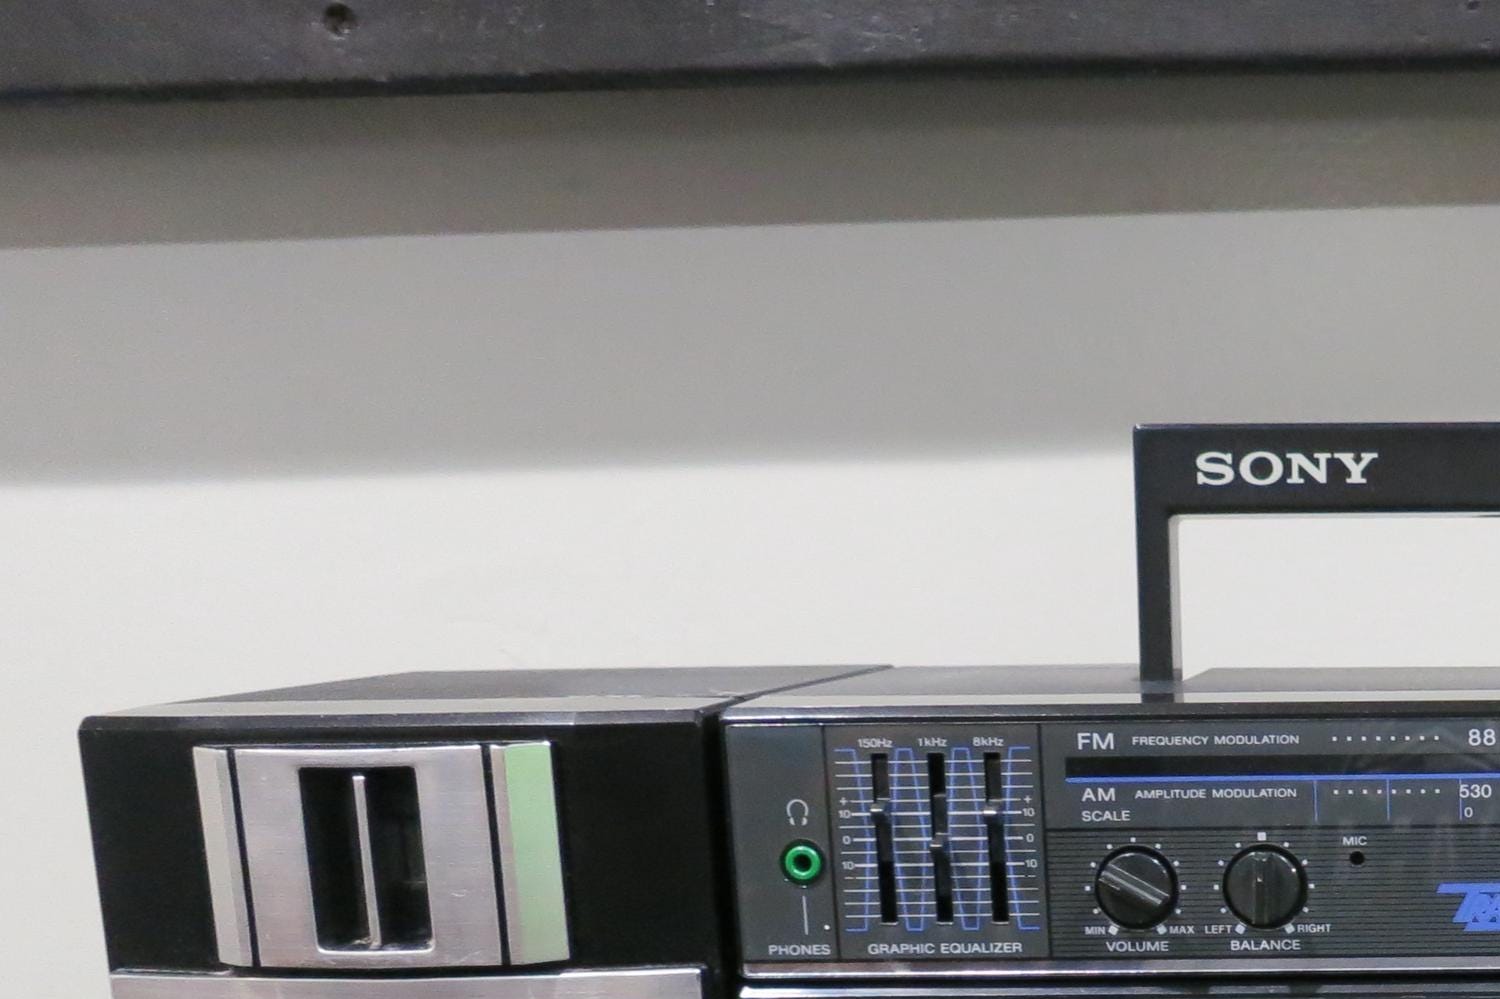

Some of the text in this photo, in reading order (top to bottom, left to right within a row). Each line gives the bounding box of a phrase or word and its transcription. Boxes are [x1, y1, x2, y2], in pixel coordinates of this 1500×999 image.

[1195, 451, 1379, 486] SONY
[918, 737, 947, 747] 1kHz
[972, 737, 1004, 747] 8kHz
[1077, 732, 1299, 750] FM FREQUENCY MODULATION
[1468, 729, 1496, 746] 88
[857, 738, 893, 748] 150Hz
[1081, 788, 1297, 801] AM AMPLITUDE MODULATION
[1459, 785, 1492, 798] 530
[838, 810, 851, 819] 10
[1022, 807, 1035, 817] 10
[1082, 810, 1130, 822] SCALE
[1464, 807, 1473, 818] 0
[842, 835, 851, 845] 0
[1026, 833, 1035, 843] 0
[1342, 836, 1367, 846] MIC
[842, 861, 855, 870] 10
[1025, 859, 1038, 868] 10
[1085, 926, 1106, 935] MIN
[1170, 925, 1194, 934] MAX
[1205, 924, 1232, 934] LEFT
[1297, 923, 1331, 933] RIGHT
[768, 944, 831, 956] PHONES
[868, 942, 1022, 955] GRAPHIC EQUALIZER
[1106, 941, 1169, 952] VOLUME
[1230, 940, 1301, 950] BALANCE
